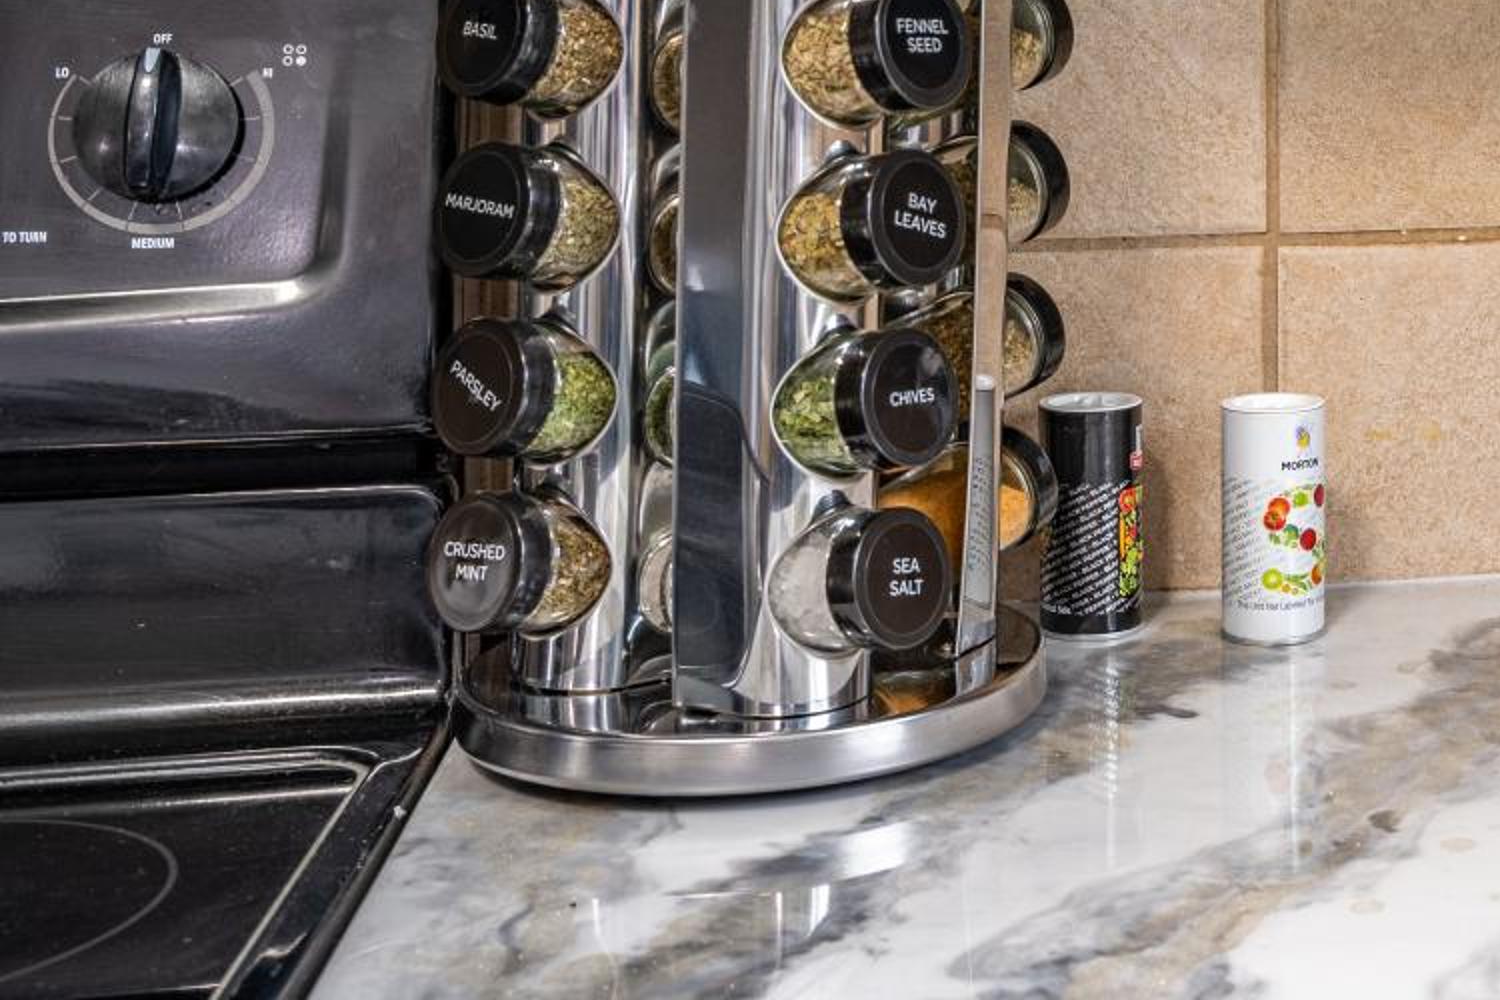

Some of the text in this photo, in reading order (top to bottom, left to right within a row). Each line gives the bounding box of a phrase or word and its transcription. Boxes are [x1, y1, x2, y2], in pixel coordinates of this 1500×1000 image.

[463, 20, 497, 40] BASIL
[895, 16, 949, 35] FENNEL
[153, 34, 174, 44] OFF
[907, 36, 943, 53] SEED
[55, 67, 70, 79] LO
[263, 67, 274, 78] HI
[445, 193, 516, 219] MARJORAM
[908, 191, 938, 215] BAY
[894, 208, 946, 239] LEAVES
[2, 231, 47, 243] TO TURN
[131, 237, 176, 249] MEDIUM
[449, 359, 502, 412] PARSLEY
[889, 387, 935, 407] CHIVES
[444, 541, 505, 561] CRUSHED
[455, 563, 488, 582] MINT
[892, 556, 921, 575] SEA
[889, 578, 926, 597] SALT
